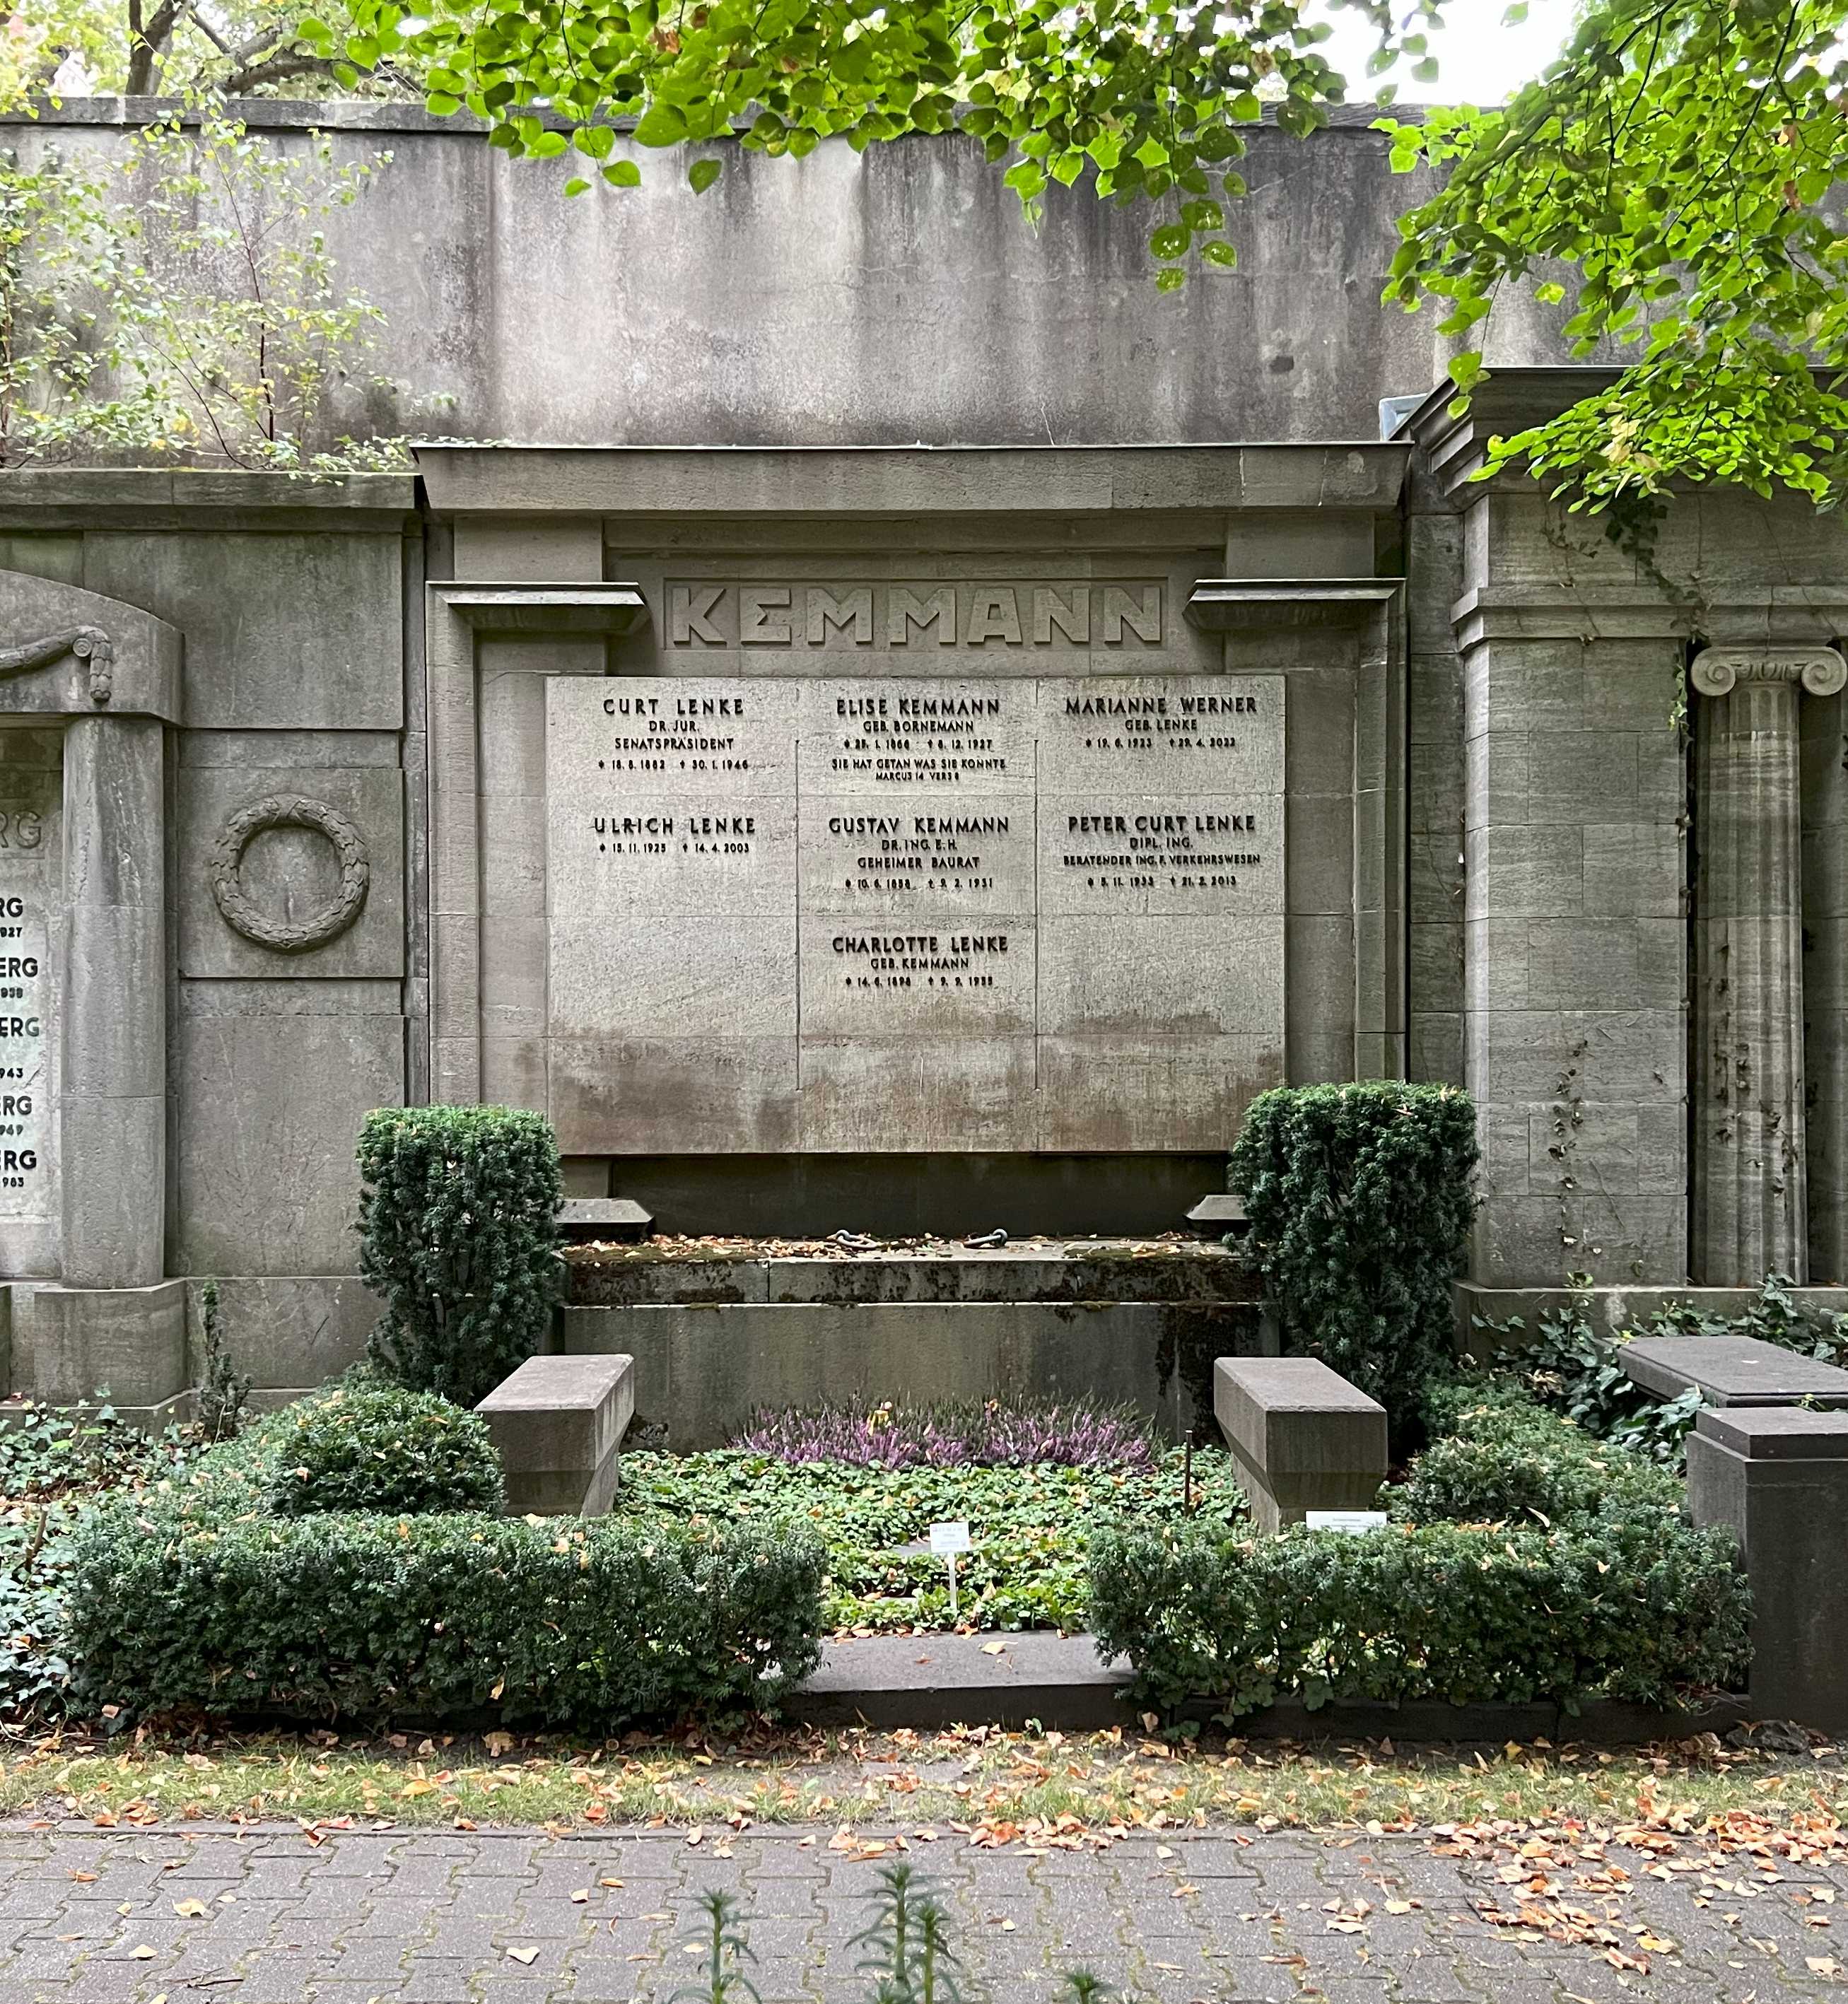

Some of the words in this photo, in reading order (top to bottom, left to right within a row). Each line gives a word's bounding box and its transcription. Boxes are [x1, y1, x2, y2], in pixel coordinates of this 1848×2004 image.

[672, 587, 1162, 646] KEMMANN
[602, 698, 659, 715] CURT
[677, 698, 744, 715] LENKE
[836, 698, 888, 715] ELISE
[898, 698, 1000, 715] KEMMANN
[1065, 696, 1166, 715] MARIANNE
[1179, 696, 1257, 715] WERNER
[862, 720, 889, 733] GEB.
[893, 720, 974, 733] BORNEMANN
[1124, 718, 1152, 731] GEB.
[1157, 718, 1198, 731] LENKE
[614, 736, 735, 750] SENATSPRÄSIDENT
[831, 758, 849, 770] SIE
[853, 758, 872, 770] HAT
[876, 758, 911, 770] GETAN
[913, 758, 936, 770] WAS
[940, 758, 957, 770] SIE
[961, 758, 1006, 770] KONNTE
[875, 771, 912, 781] MARCUS
[915, 771, 924, 781] 14
[929, 771, 953, 781] VERS
[594, 817, 673, 834] ULRICH
[689, 817, 756, 834] LENKE
[829, 816, 899, 834] GUSTAV
[913, 816, 1009, 834] KEMMANN
[1068, 815, 1127, 833] PETER
[1134, 815, 1187, 833] CURT
[1195, 815, 1256, 833] LENKE
[857, 856, 923, 869] GEHEIMER
[931, 856, 980, 869] BAURAT
[1063, 854, 1133, 867] BERATENDER
[1168, 854, 1261, 867] VERKEHRSWESEN
[831, 936, 939, 953] CHARLOTTE
[950, 936, 1008, 953] LENKE
[870, 958, 899, 970] GEB.
[902, 958, 969, 970] KEMMANN
[0, 1095, 33, 1116] RG
[0, 1149, 37, 1171] RG
